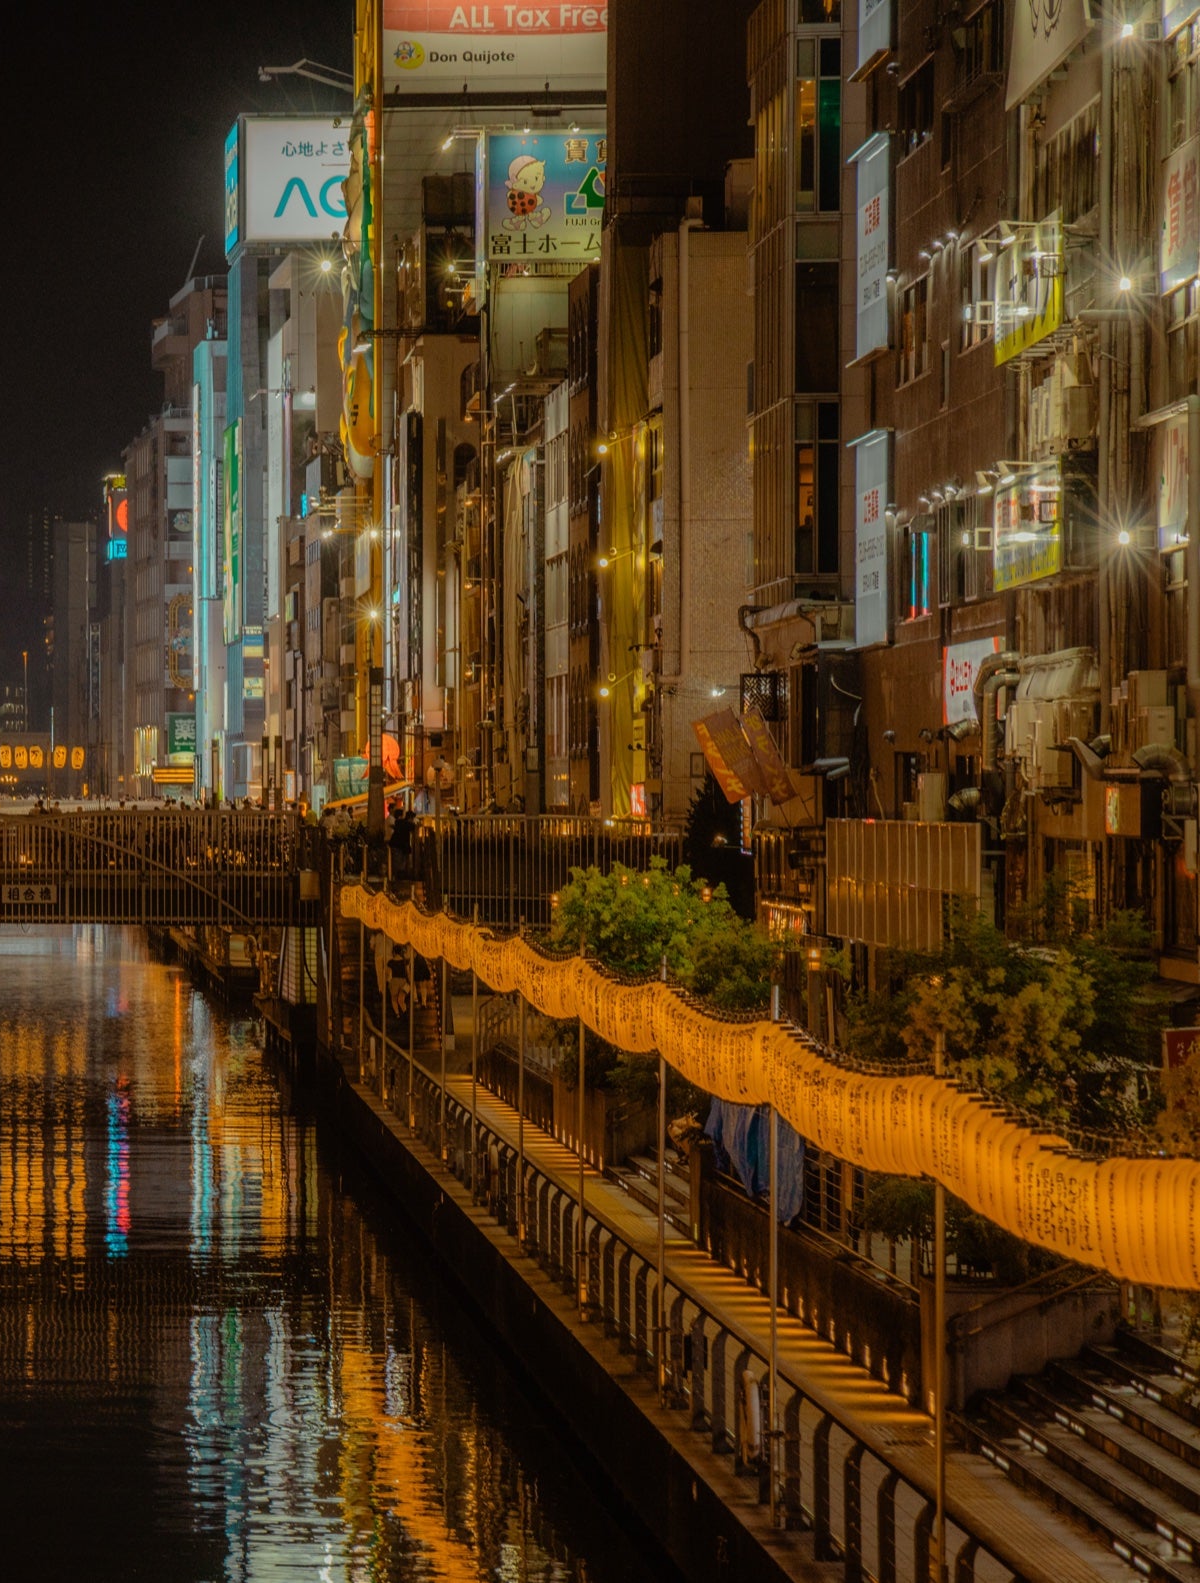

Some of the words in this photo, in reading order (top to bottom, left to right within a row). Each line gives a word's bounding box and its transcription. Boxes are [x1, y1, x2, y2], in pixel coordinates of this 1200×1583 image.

[449, 7, 494, 28] ALL
[504, 6, 550, 28] Tax
[429, 51, 457, 63] Don
[462, 50, 515, 66] Quijote
[281, 141, 345, 157] 心地よさ
[565, 218, 587, 227] FUJI
[491, 233, 601, 255] 富士ホーム
